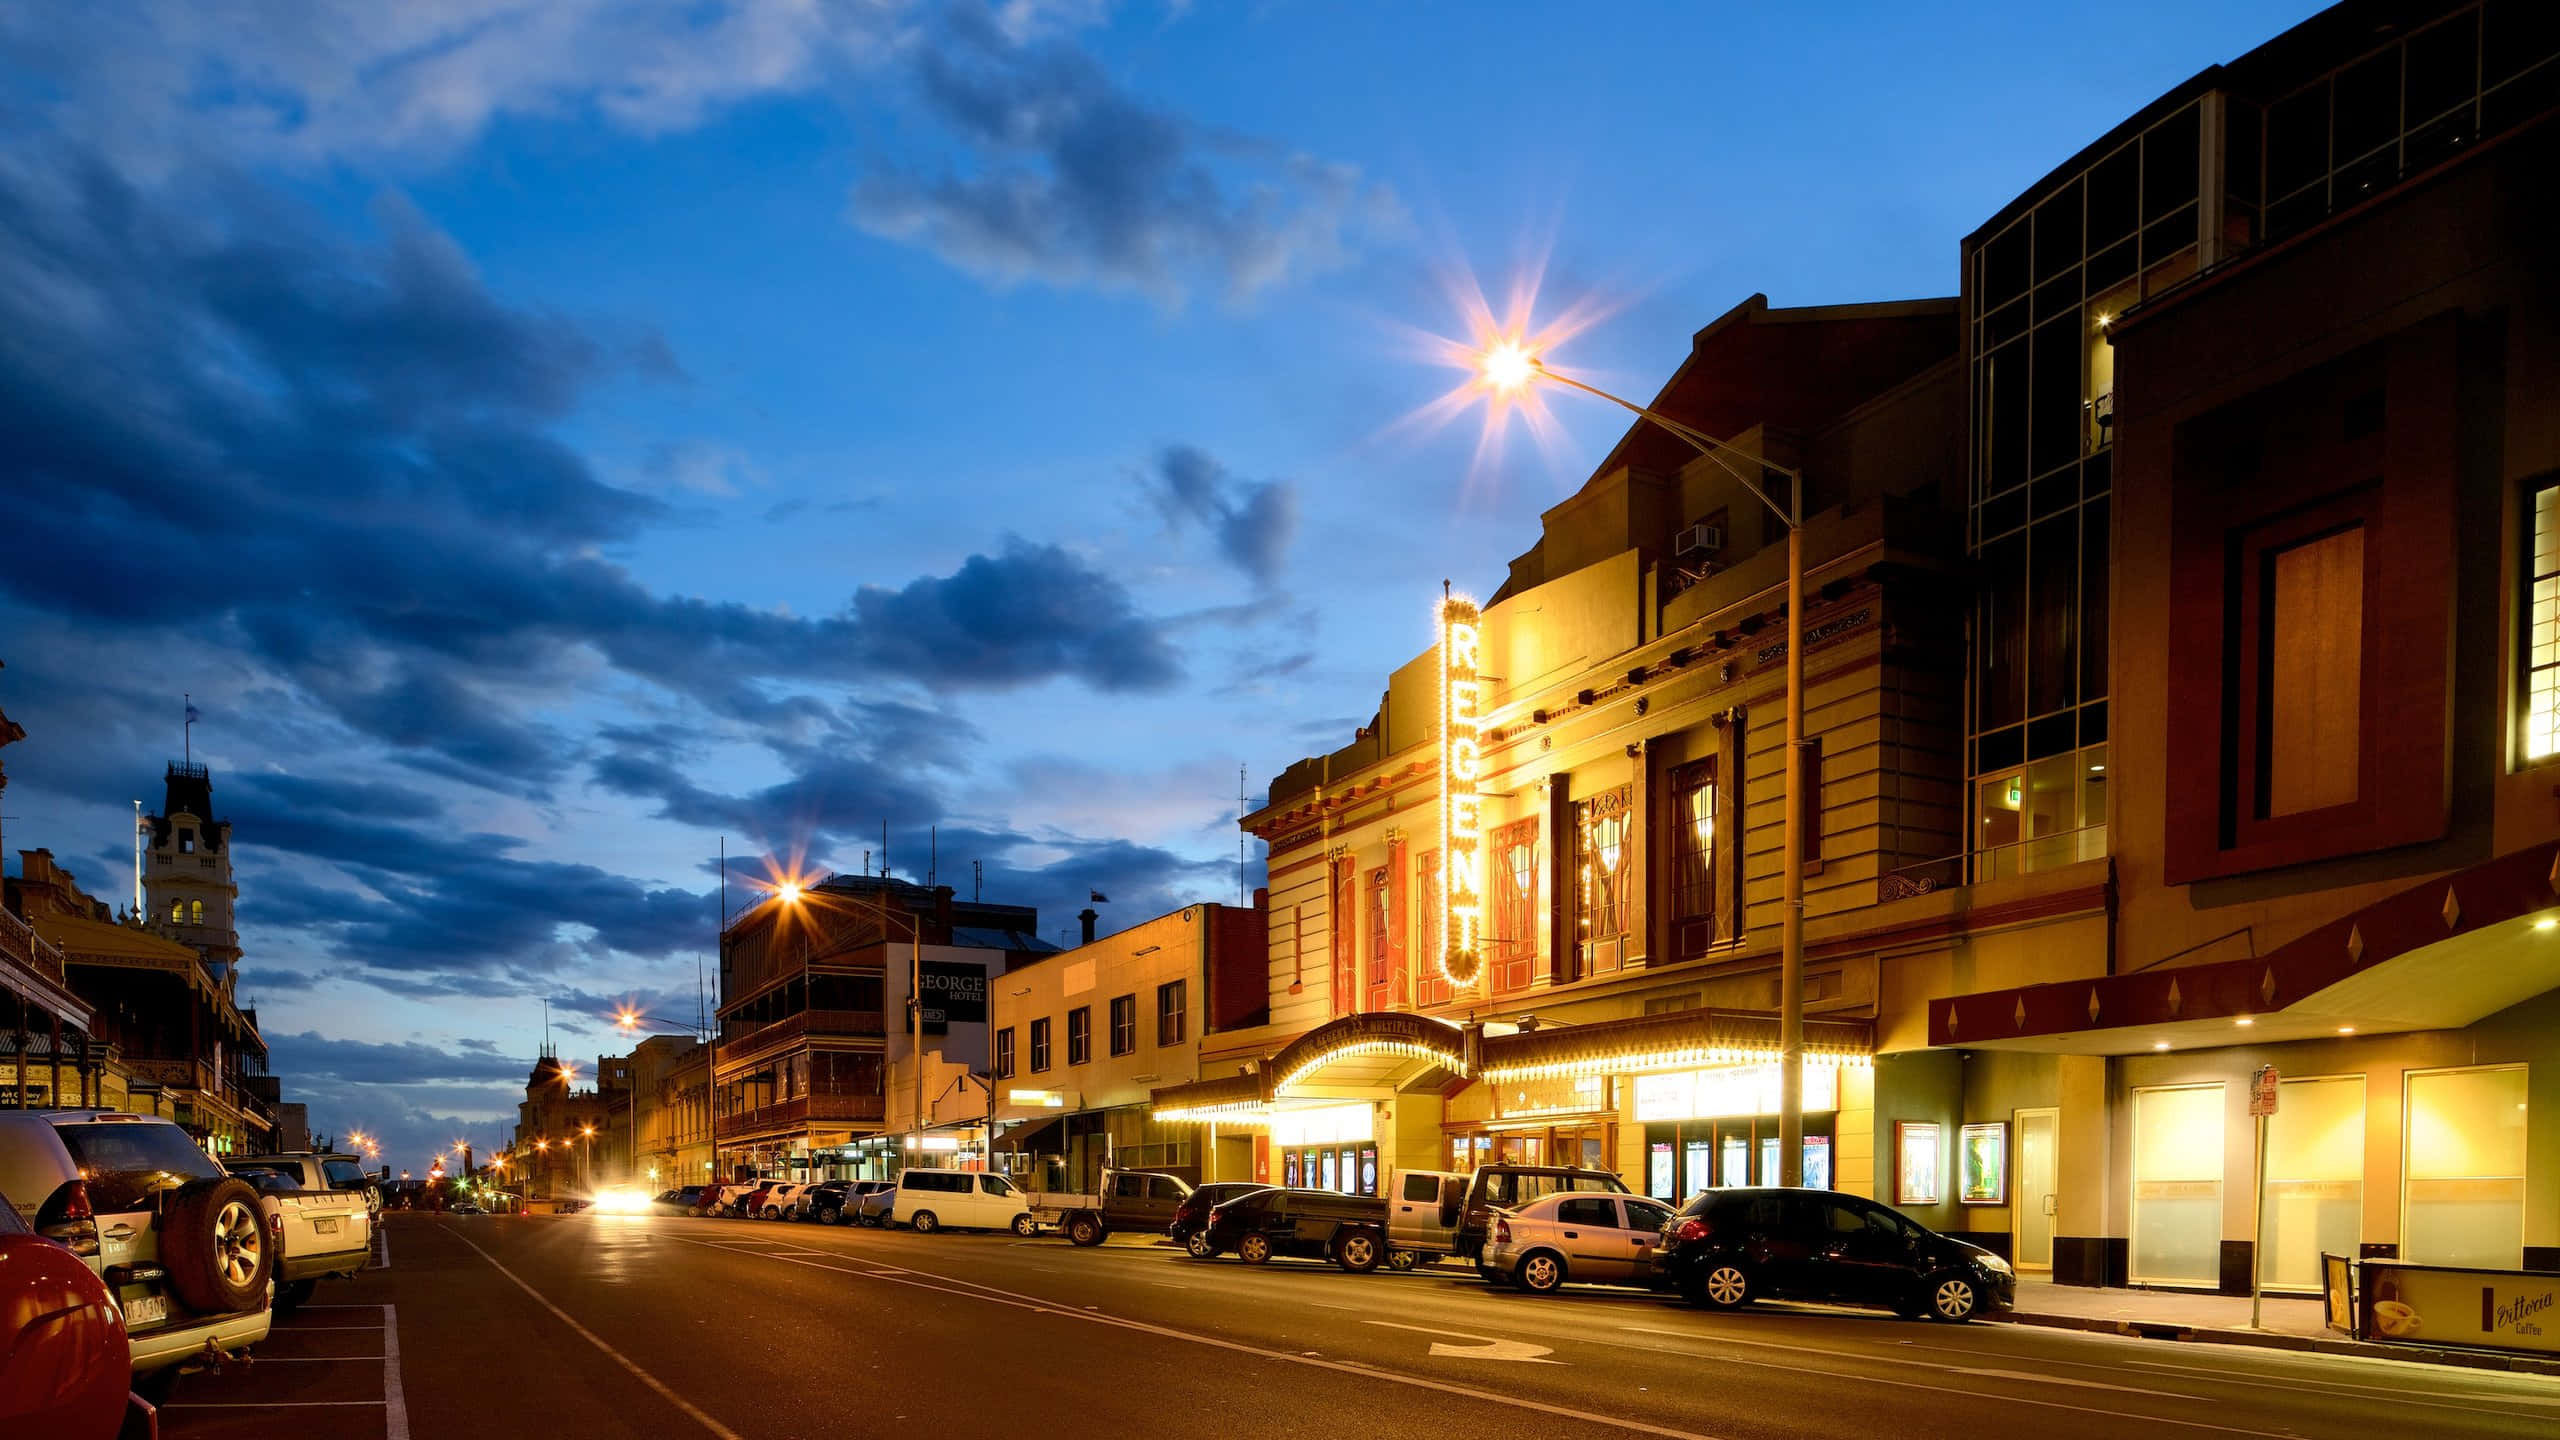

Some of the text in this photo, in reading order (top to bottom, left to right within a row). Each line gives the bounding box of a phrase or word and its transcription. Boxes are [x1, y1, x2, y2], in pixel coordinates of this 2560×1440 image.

[1450, 622, 1480, 952] REGENT
[949, 991, 985, 1002] HOTEL
[1369, 1020, 1421, 1036] MULTIPLEX
[2496, 1291, 2553, 1329] Vittoria
[2515, 1321, 2542, 1337] Coffee
